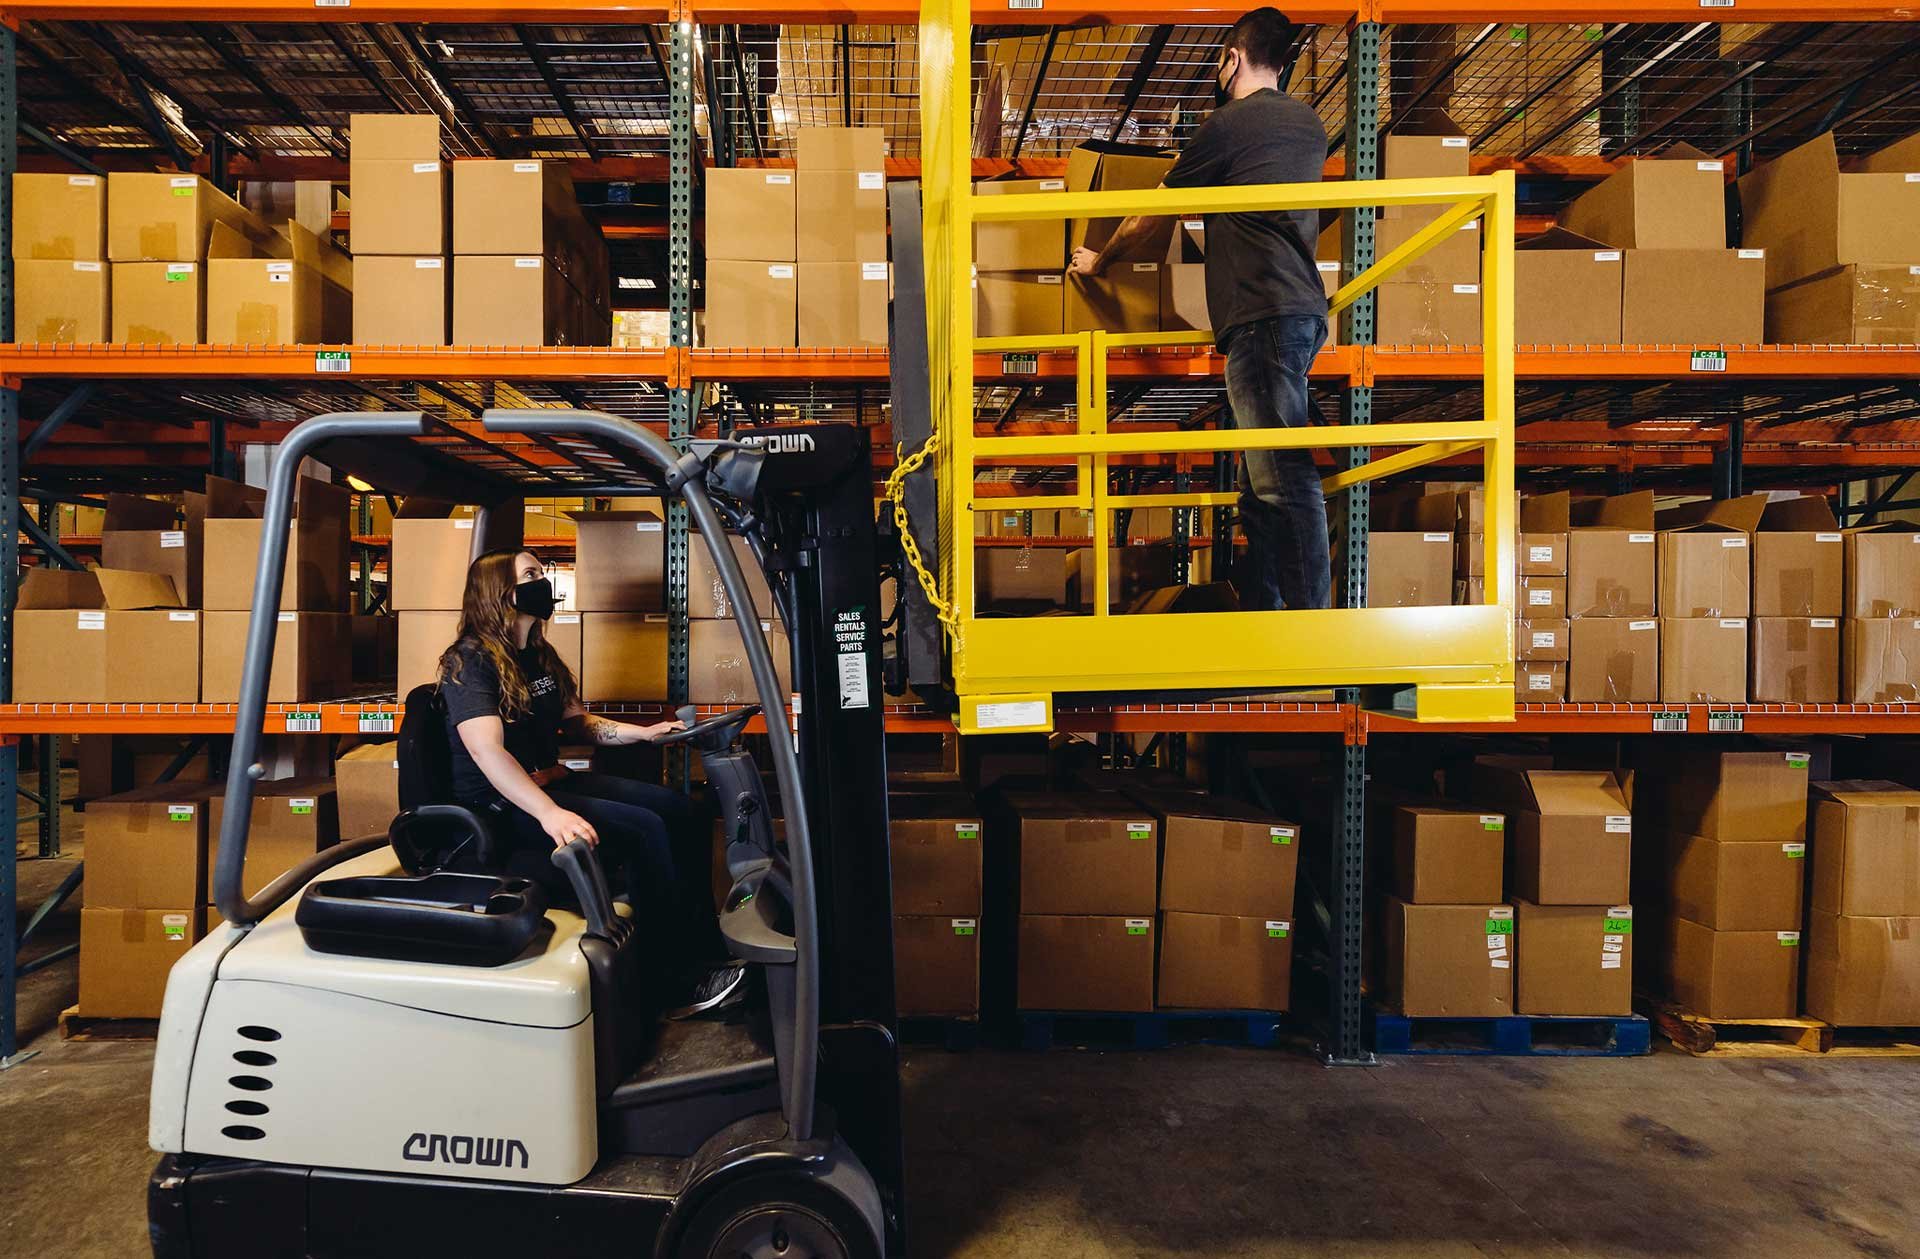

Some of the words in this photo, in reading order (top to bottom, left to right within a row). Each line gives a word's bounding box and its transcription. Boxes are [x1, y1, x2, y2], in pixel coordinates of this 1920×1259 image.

[838, 612, 861, 621] SALES
[834, 621, 866, 632] RENTALS
[836, 631, 865, 642] SERVICE
[840, 642, 863, 652] PARTS
[403, 1133, 529, 1169] CROWN
